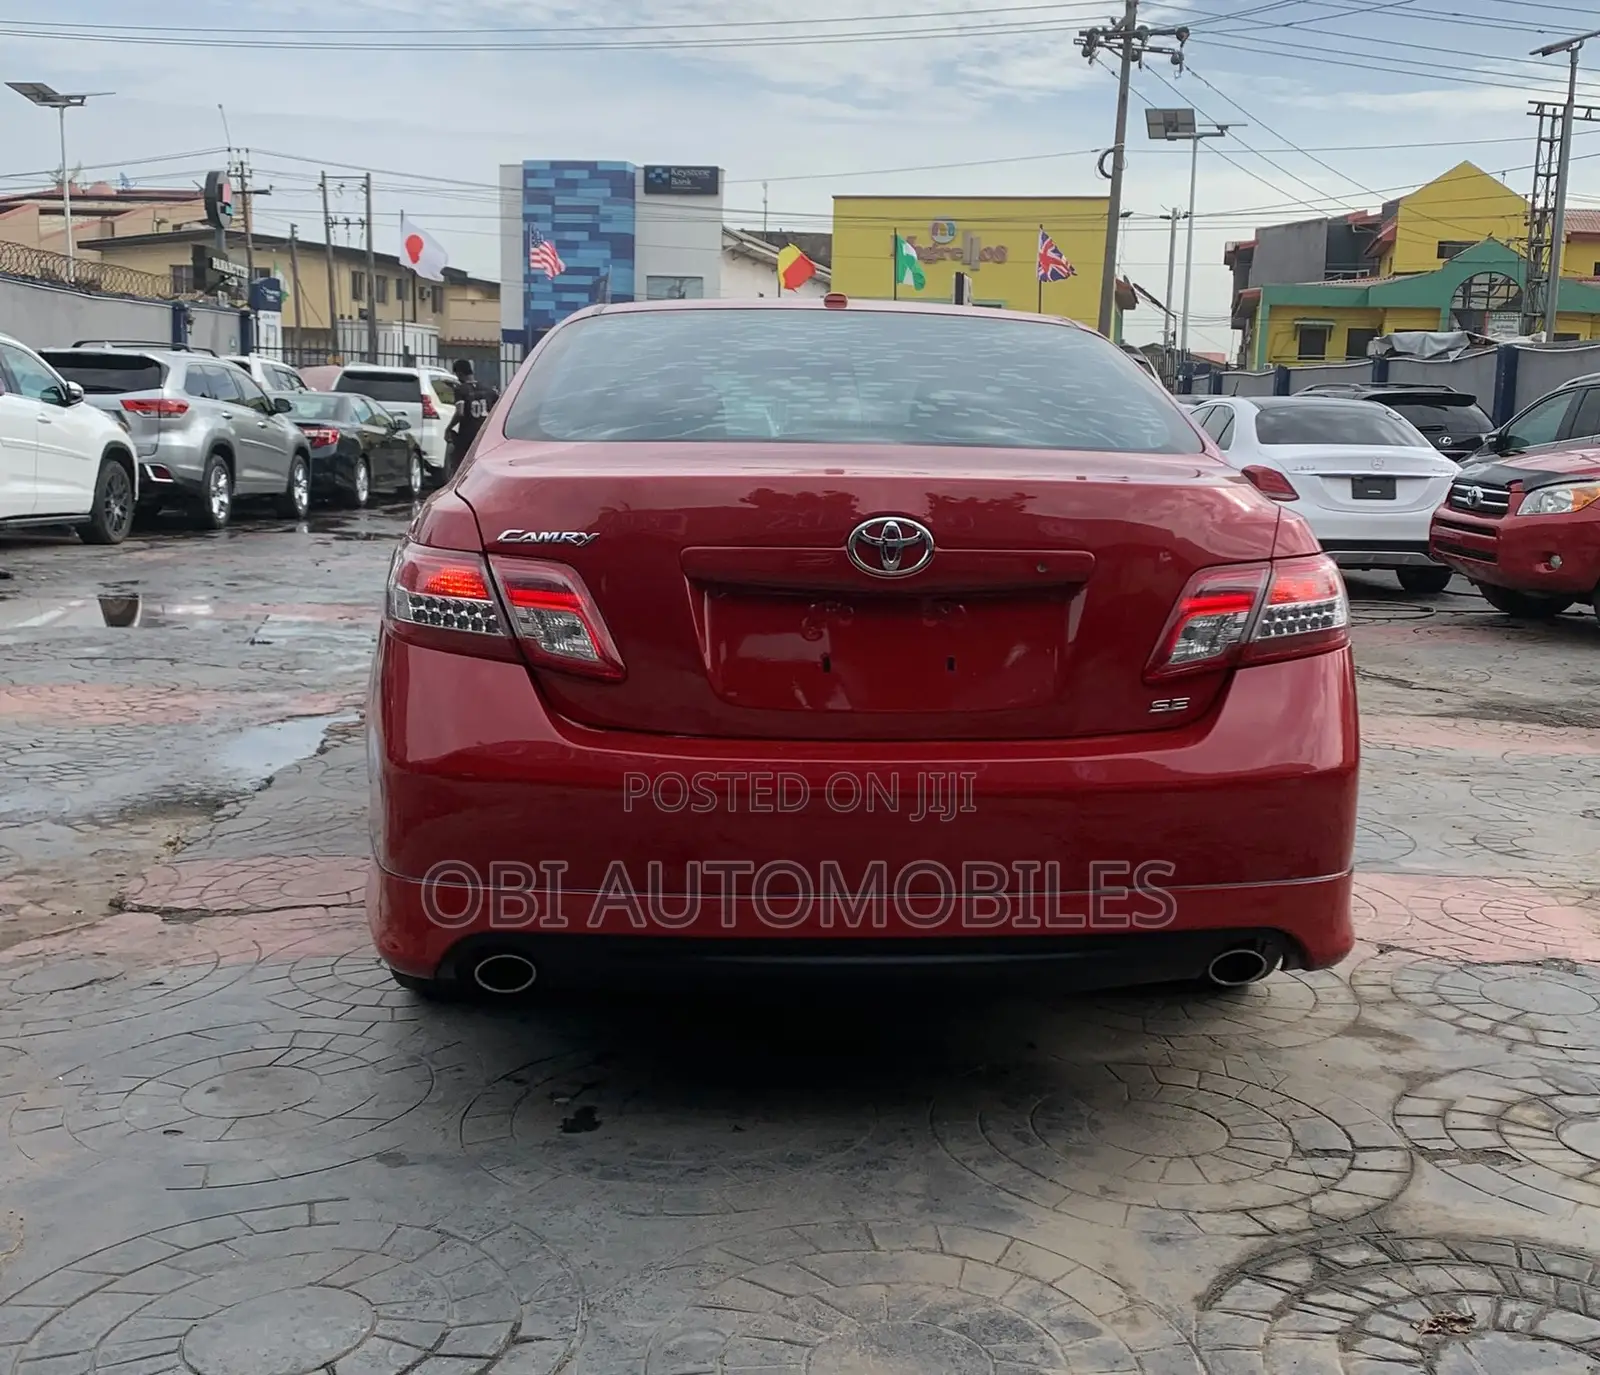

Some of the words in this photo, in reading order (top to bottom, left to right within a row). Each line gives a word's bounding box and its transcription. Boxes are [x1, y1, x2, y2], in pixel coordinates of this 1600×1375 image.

[671, 167, 710, 177] Keystone
[497, 529, 600, 547] CAMRY
[1149, 697, 1190, 713] SE
